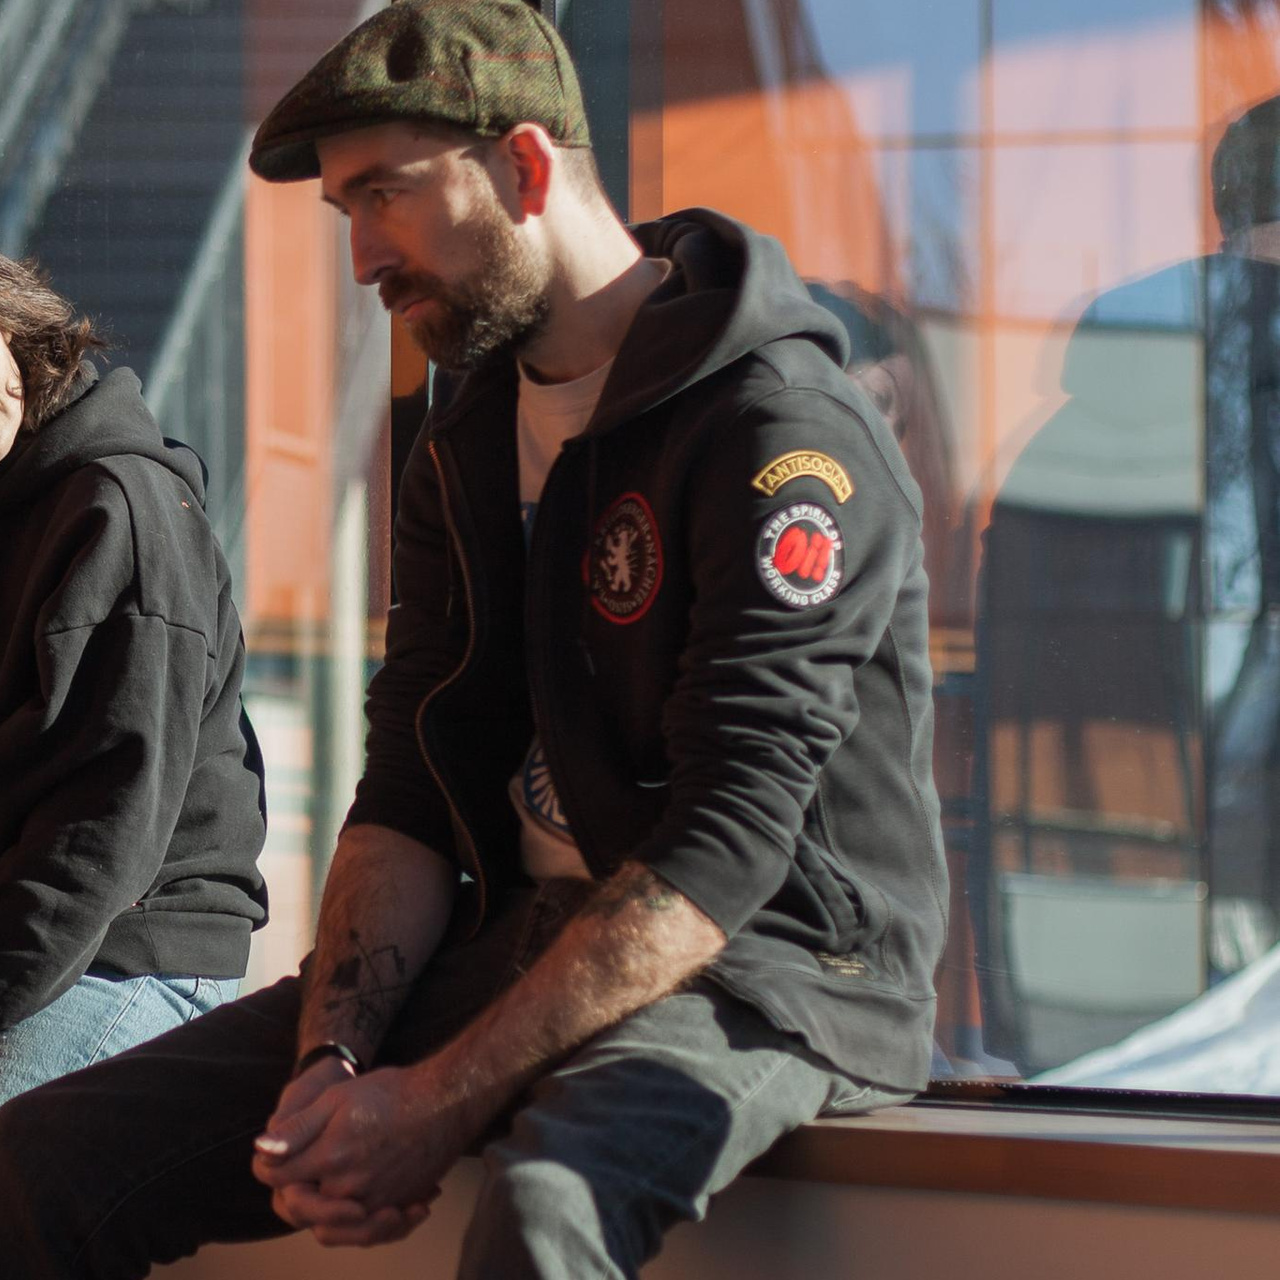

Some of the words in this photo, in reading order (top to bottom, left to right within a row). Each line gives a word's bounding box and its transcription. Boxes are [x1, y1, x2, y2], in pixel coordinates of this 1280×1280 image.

[764, 454, 848, 492] ANTISOCIAL
[763, 512, 790, 539] THE
[790, 505, 833, 528] SPIRIT
[828, 529, 842, 550] OF
[761, 555, 809, 606] WORKING
[811, 570, 841, 605] CLASS
